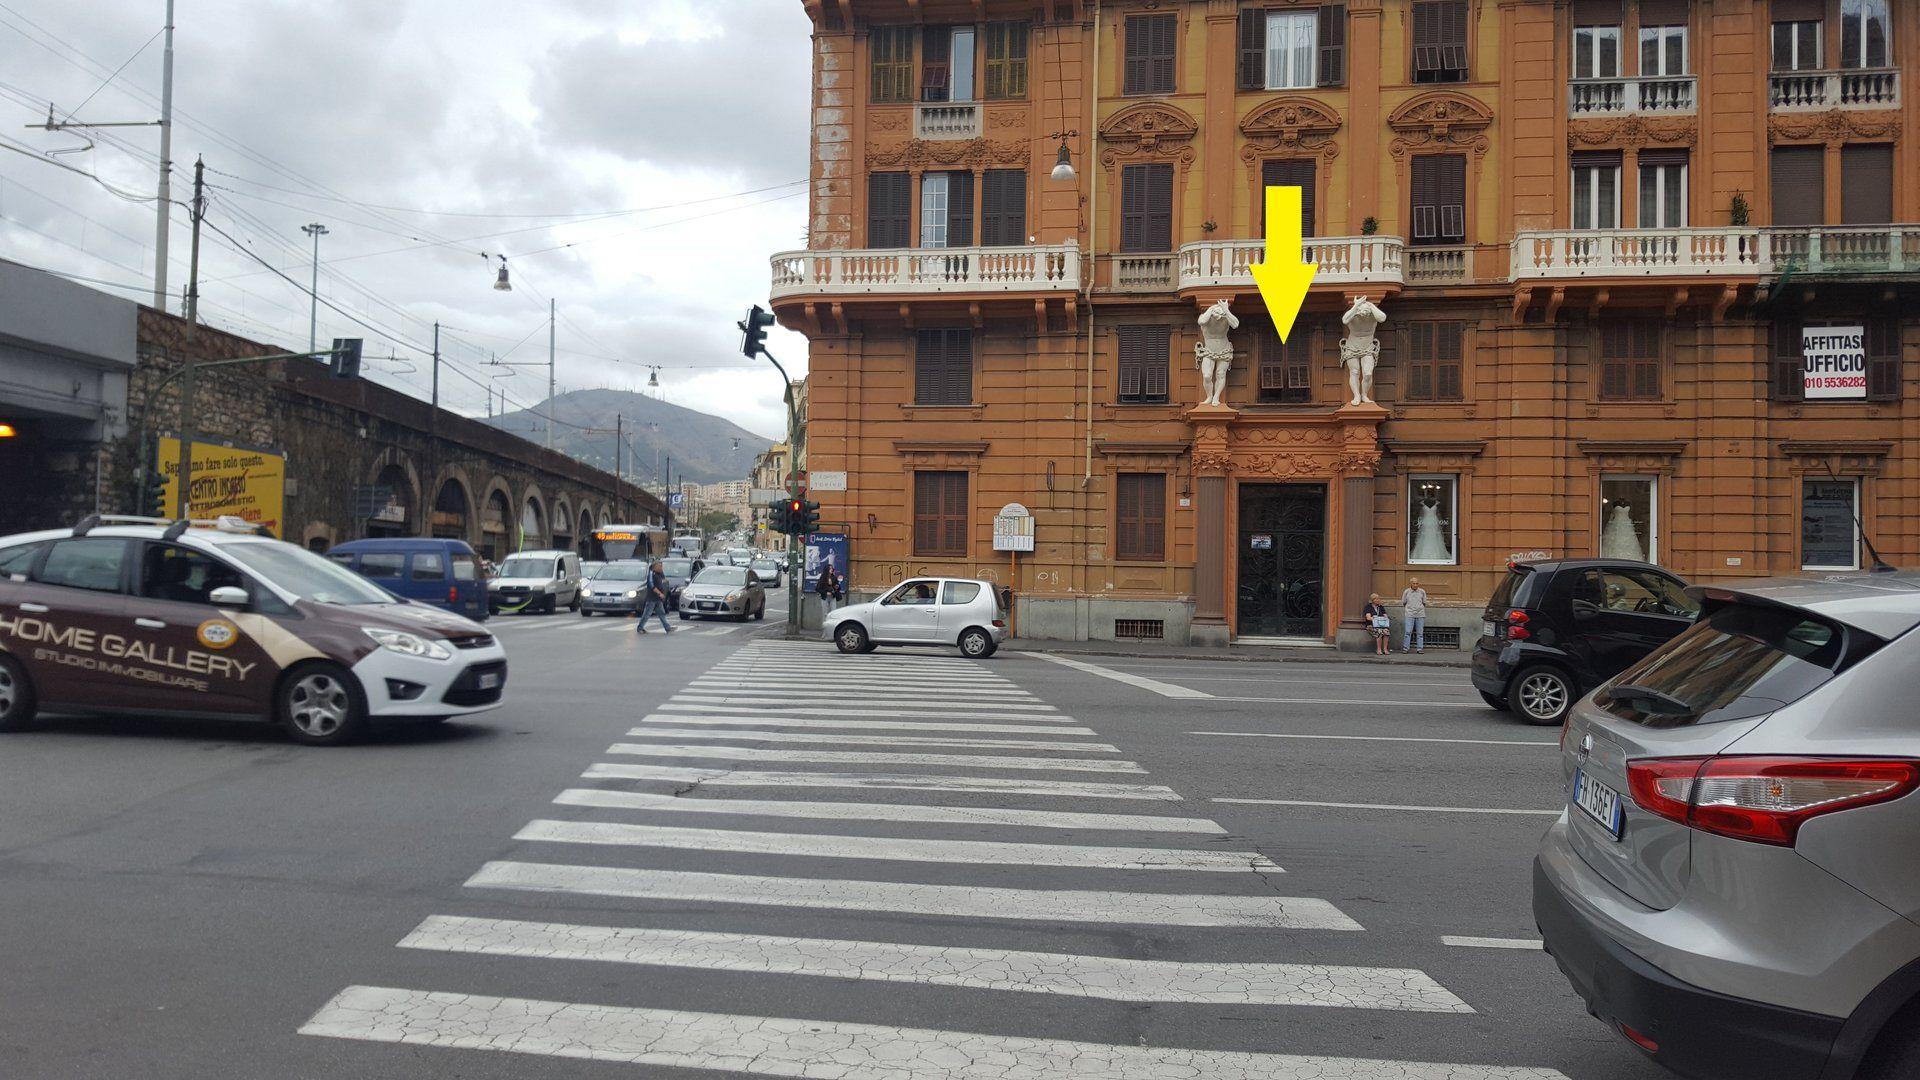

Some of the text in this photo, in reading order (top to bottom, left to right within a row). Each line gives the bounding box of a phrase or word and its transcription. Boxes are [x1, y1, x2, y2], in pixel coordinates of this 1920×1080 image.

[1804, 353, 1866, 373] UFFICIO
[1805, 376, 1867, 389] 010 5536282
[33, 648, 209, 693] STUDIO IMMOBILIARE
[101, 633, 257, 682] GALLERY
